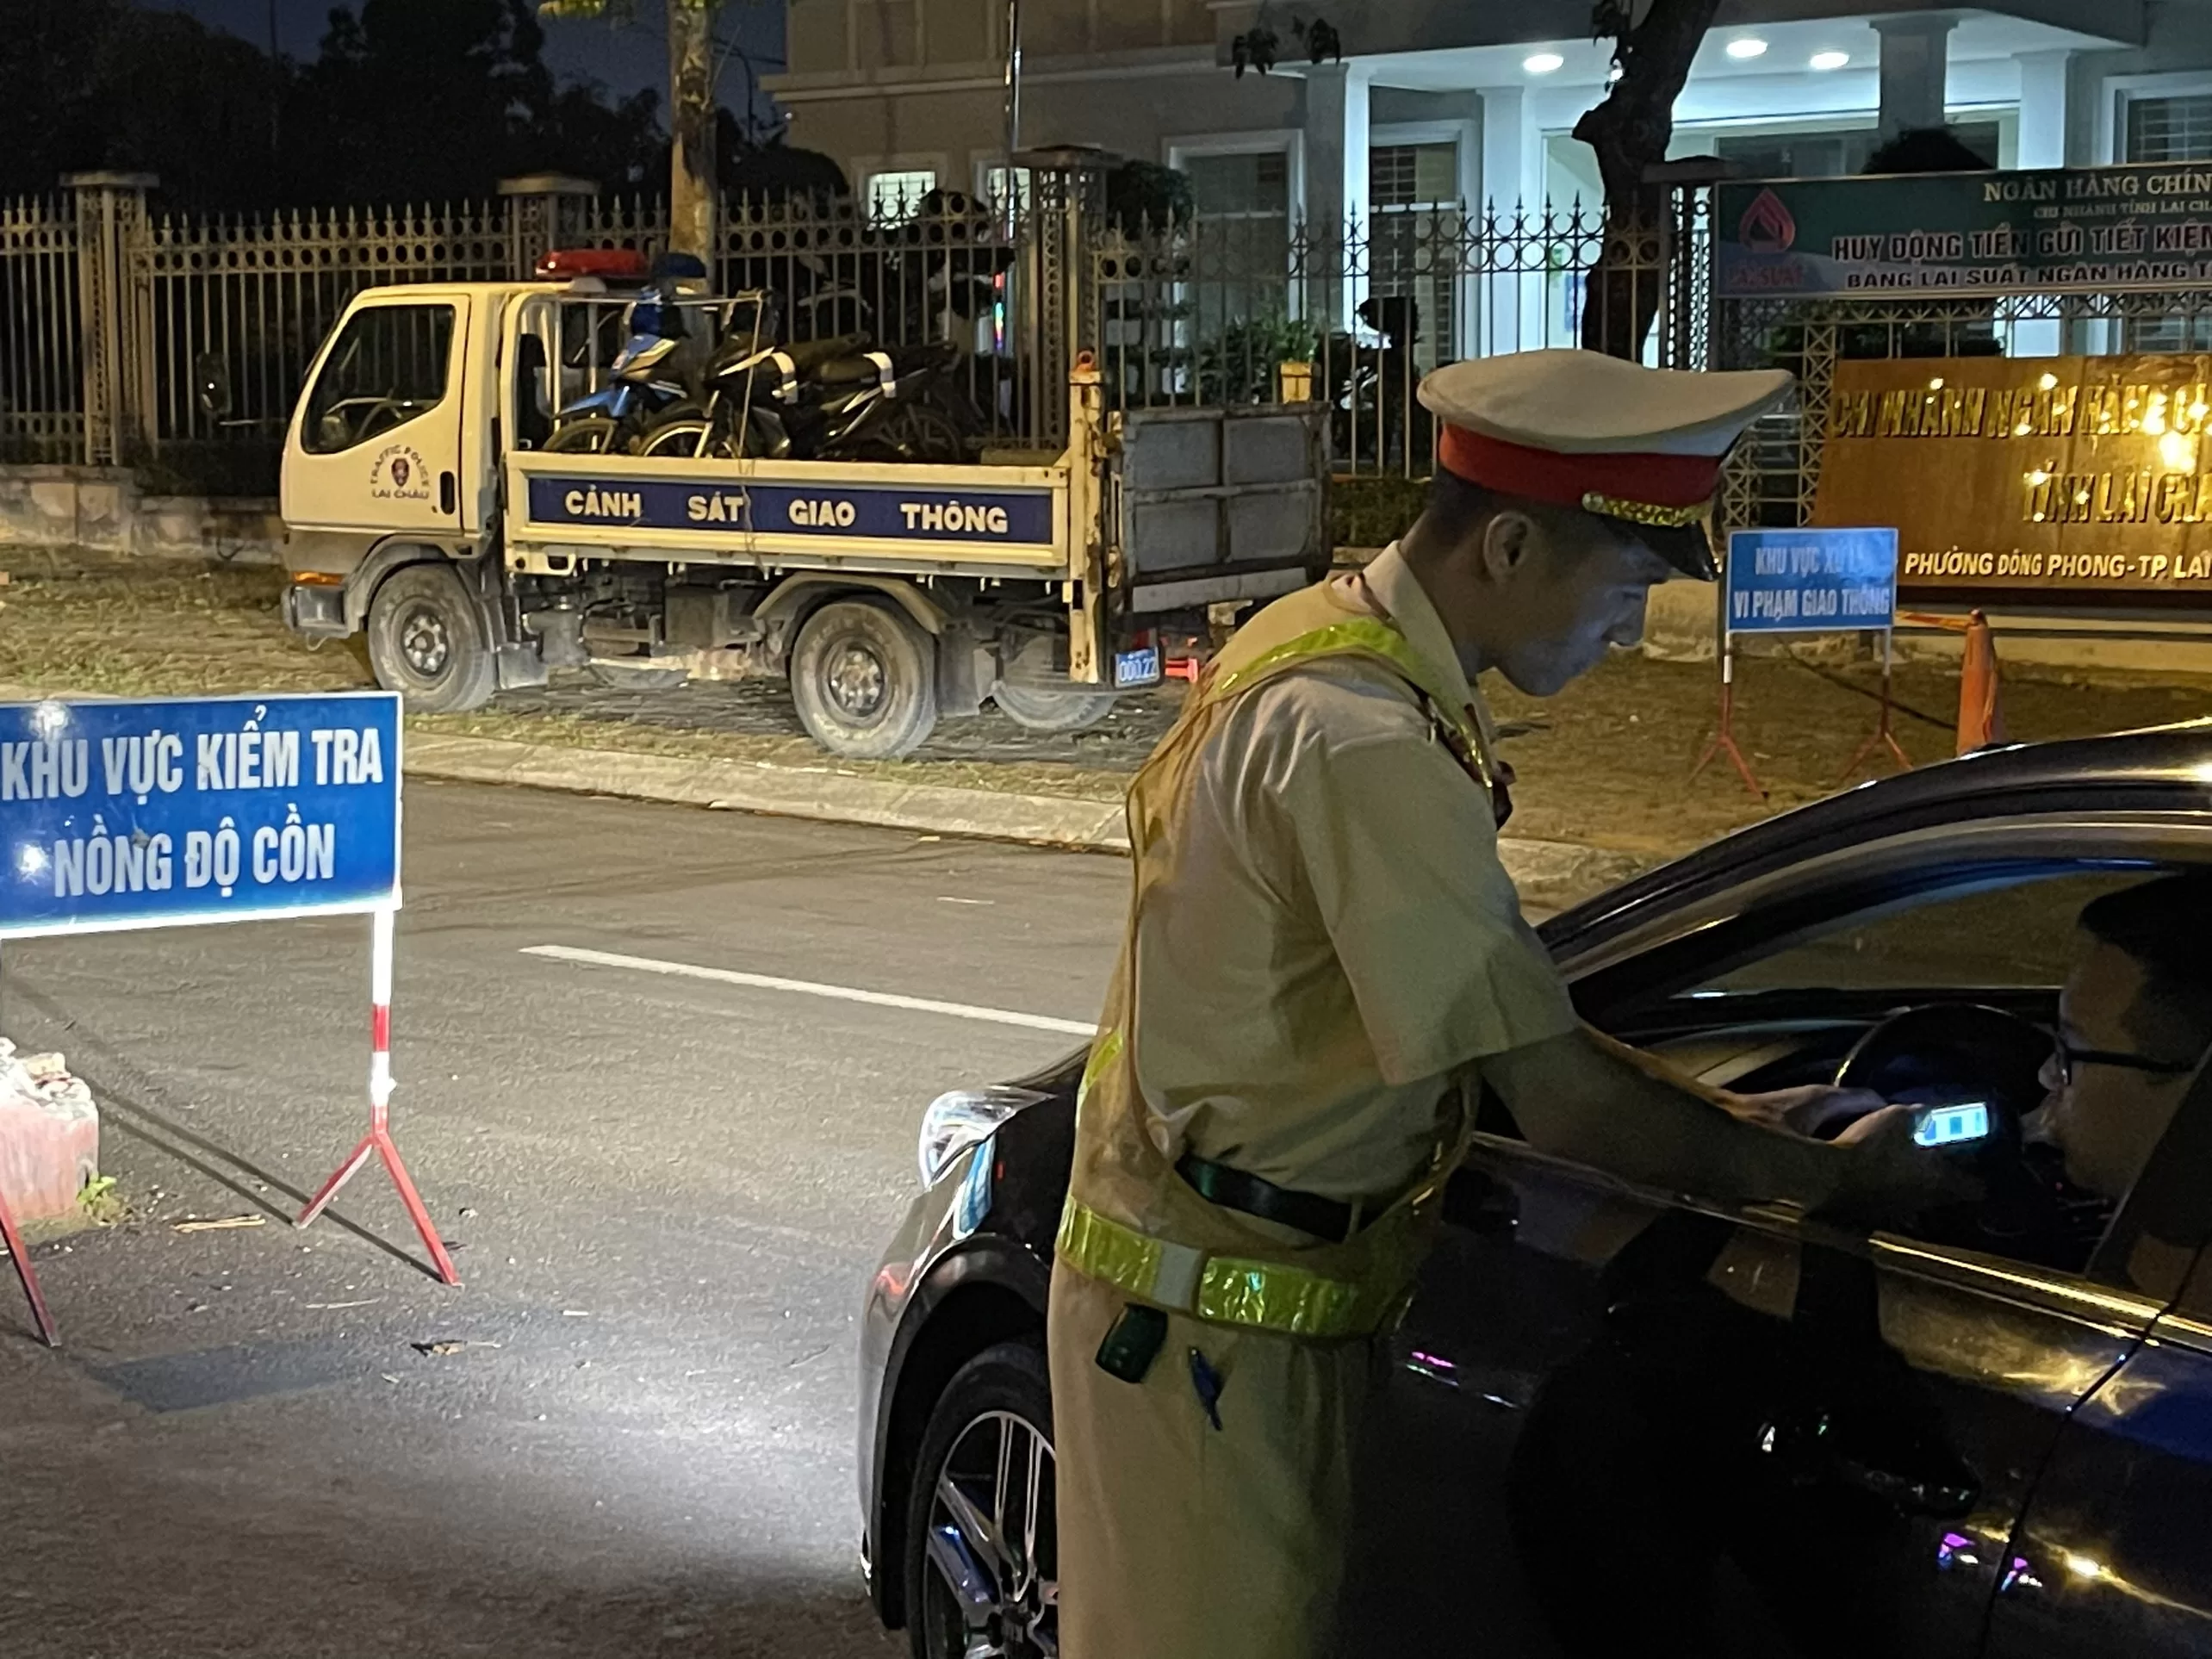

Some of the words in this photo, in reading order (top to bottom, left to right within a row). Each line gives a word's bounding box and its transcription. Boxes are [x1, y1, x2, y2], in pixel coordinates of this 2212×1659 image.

[2066, 173, 2140, 199] HÀNG
[2159, 200, 2185, 213] LAI
[1832, 234, 1885, 262] HUY
[371, 488, 391, 499] LAI
[565, 484, 642, 518] CẢNH
[687, 491, 743, 522] SÁT
[788, 499, 856, 527] GIAO
[900, 500, 1009, 533] THÔNG
[1755, 547, 1787, 575] KHU
[1904, 545, 1994, 575] PHƯỜNG
[1734, 592, 1750, 618] VI
[1752, 589, 1799, 622] PHẠM
[1802, 588, 1837, 617] GIAO
[1842, 583, 1890, 616] THÔNG
[1, 738, 87, 801] KHU
[102, 730, 183, 805] VỰC
[196, 705, 300, 791] KIỂM
[312, 728, 384, 786] TRA
[54, 813, 172, 898] NỒNG
[185, 817, 240, 898] ĐỘ
[252, 803, 335, 885] CỒN
